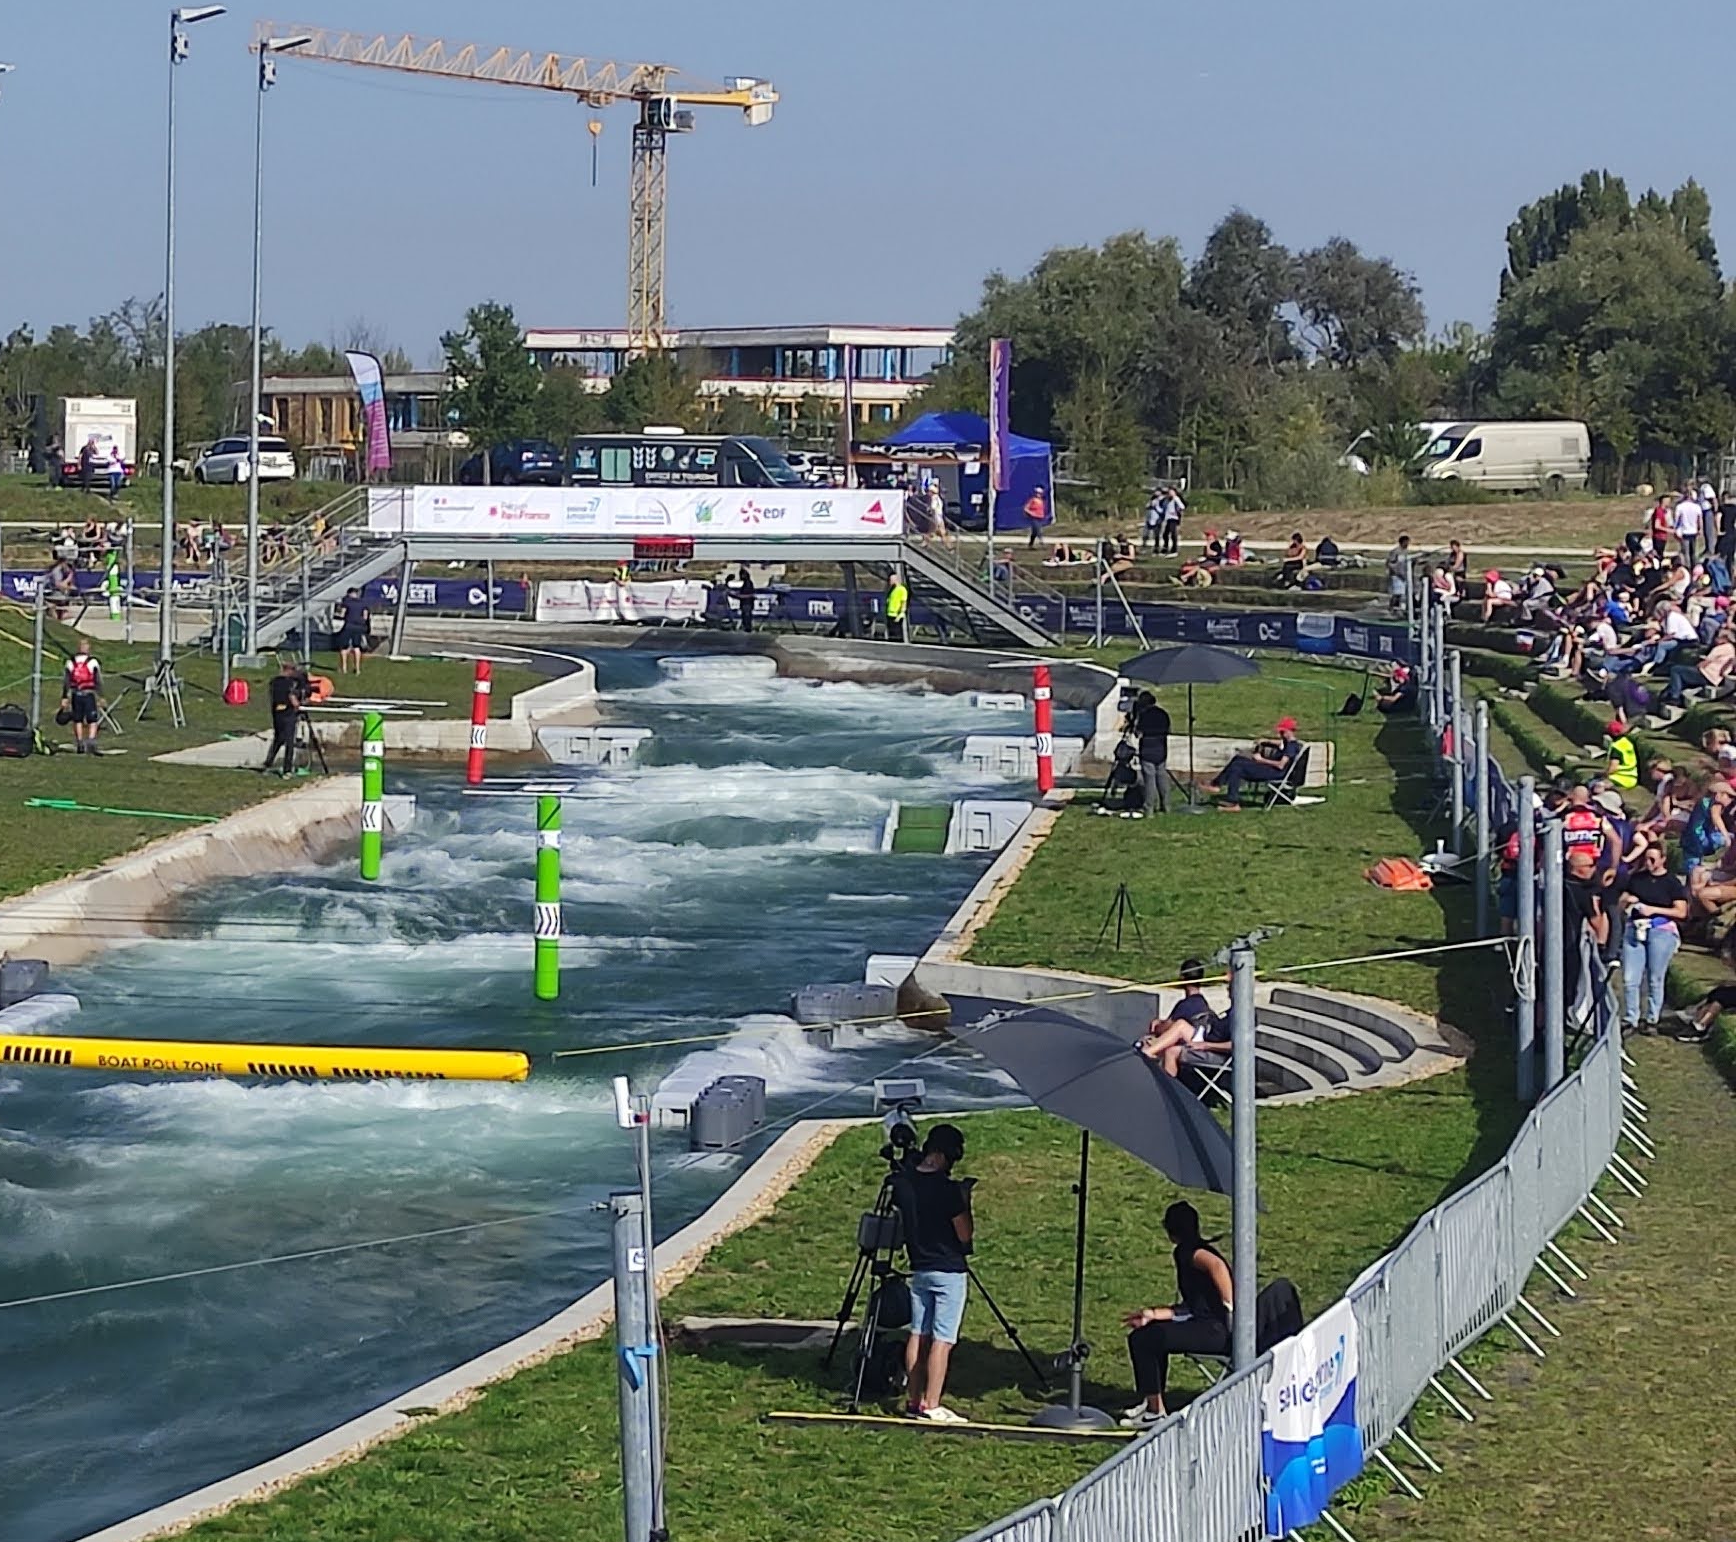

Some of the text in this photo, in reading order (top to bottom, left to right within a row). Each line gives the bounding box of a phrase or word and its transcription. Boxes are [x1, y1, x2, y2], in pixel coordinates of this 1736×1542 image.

[98, 1055, 224, 1073] BOAT ROLL ZONE
